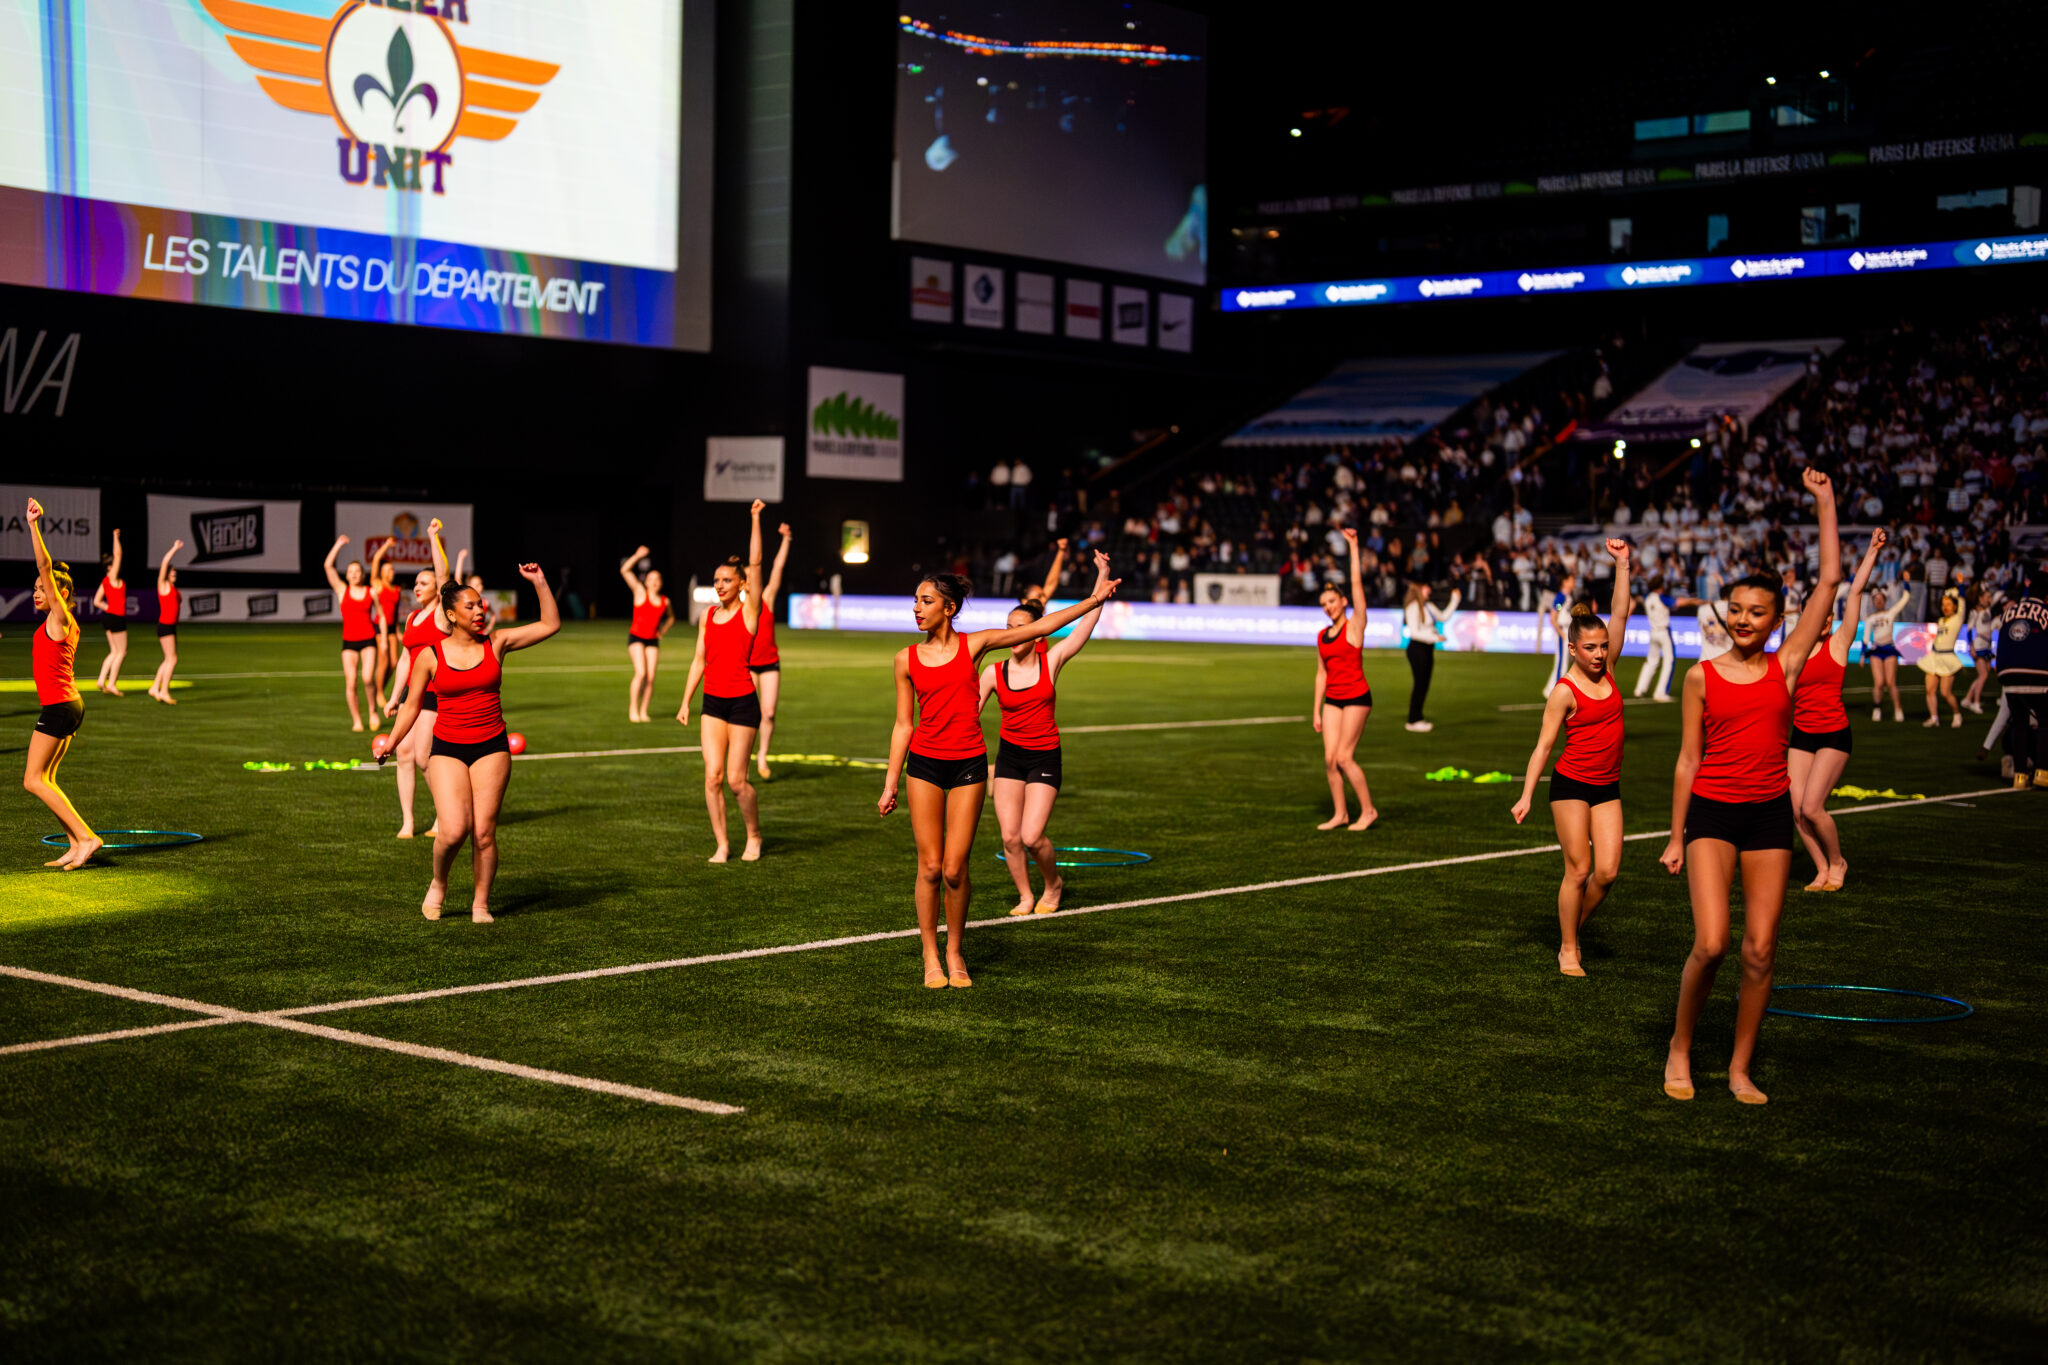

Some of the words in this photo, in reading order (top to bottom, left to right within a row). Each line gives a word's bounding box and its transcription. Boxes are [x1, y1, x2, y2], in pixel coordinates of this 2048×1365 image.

[336, 137, 453, 195] UNIT
[1906, 142, 1920, 160] LA
[144, 233, 210, 275] LES
[217, 241, 360, 290] TALENTS
[363, 258, 409, 295] DU
[412, 258, 605, 315] DÉPARTEMENT
[0, 515, 90, 536] AIXIS
